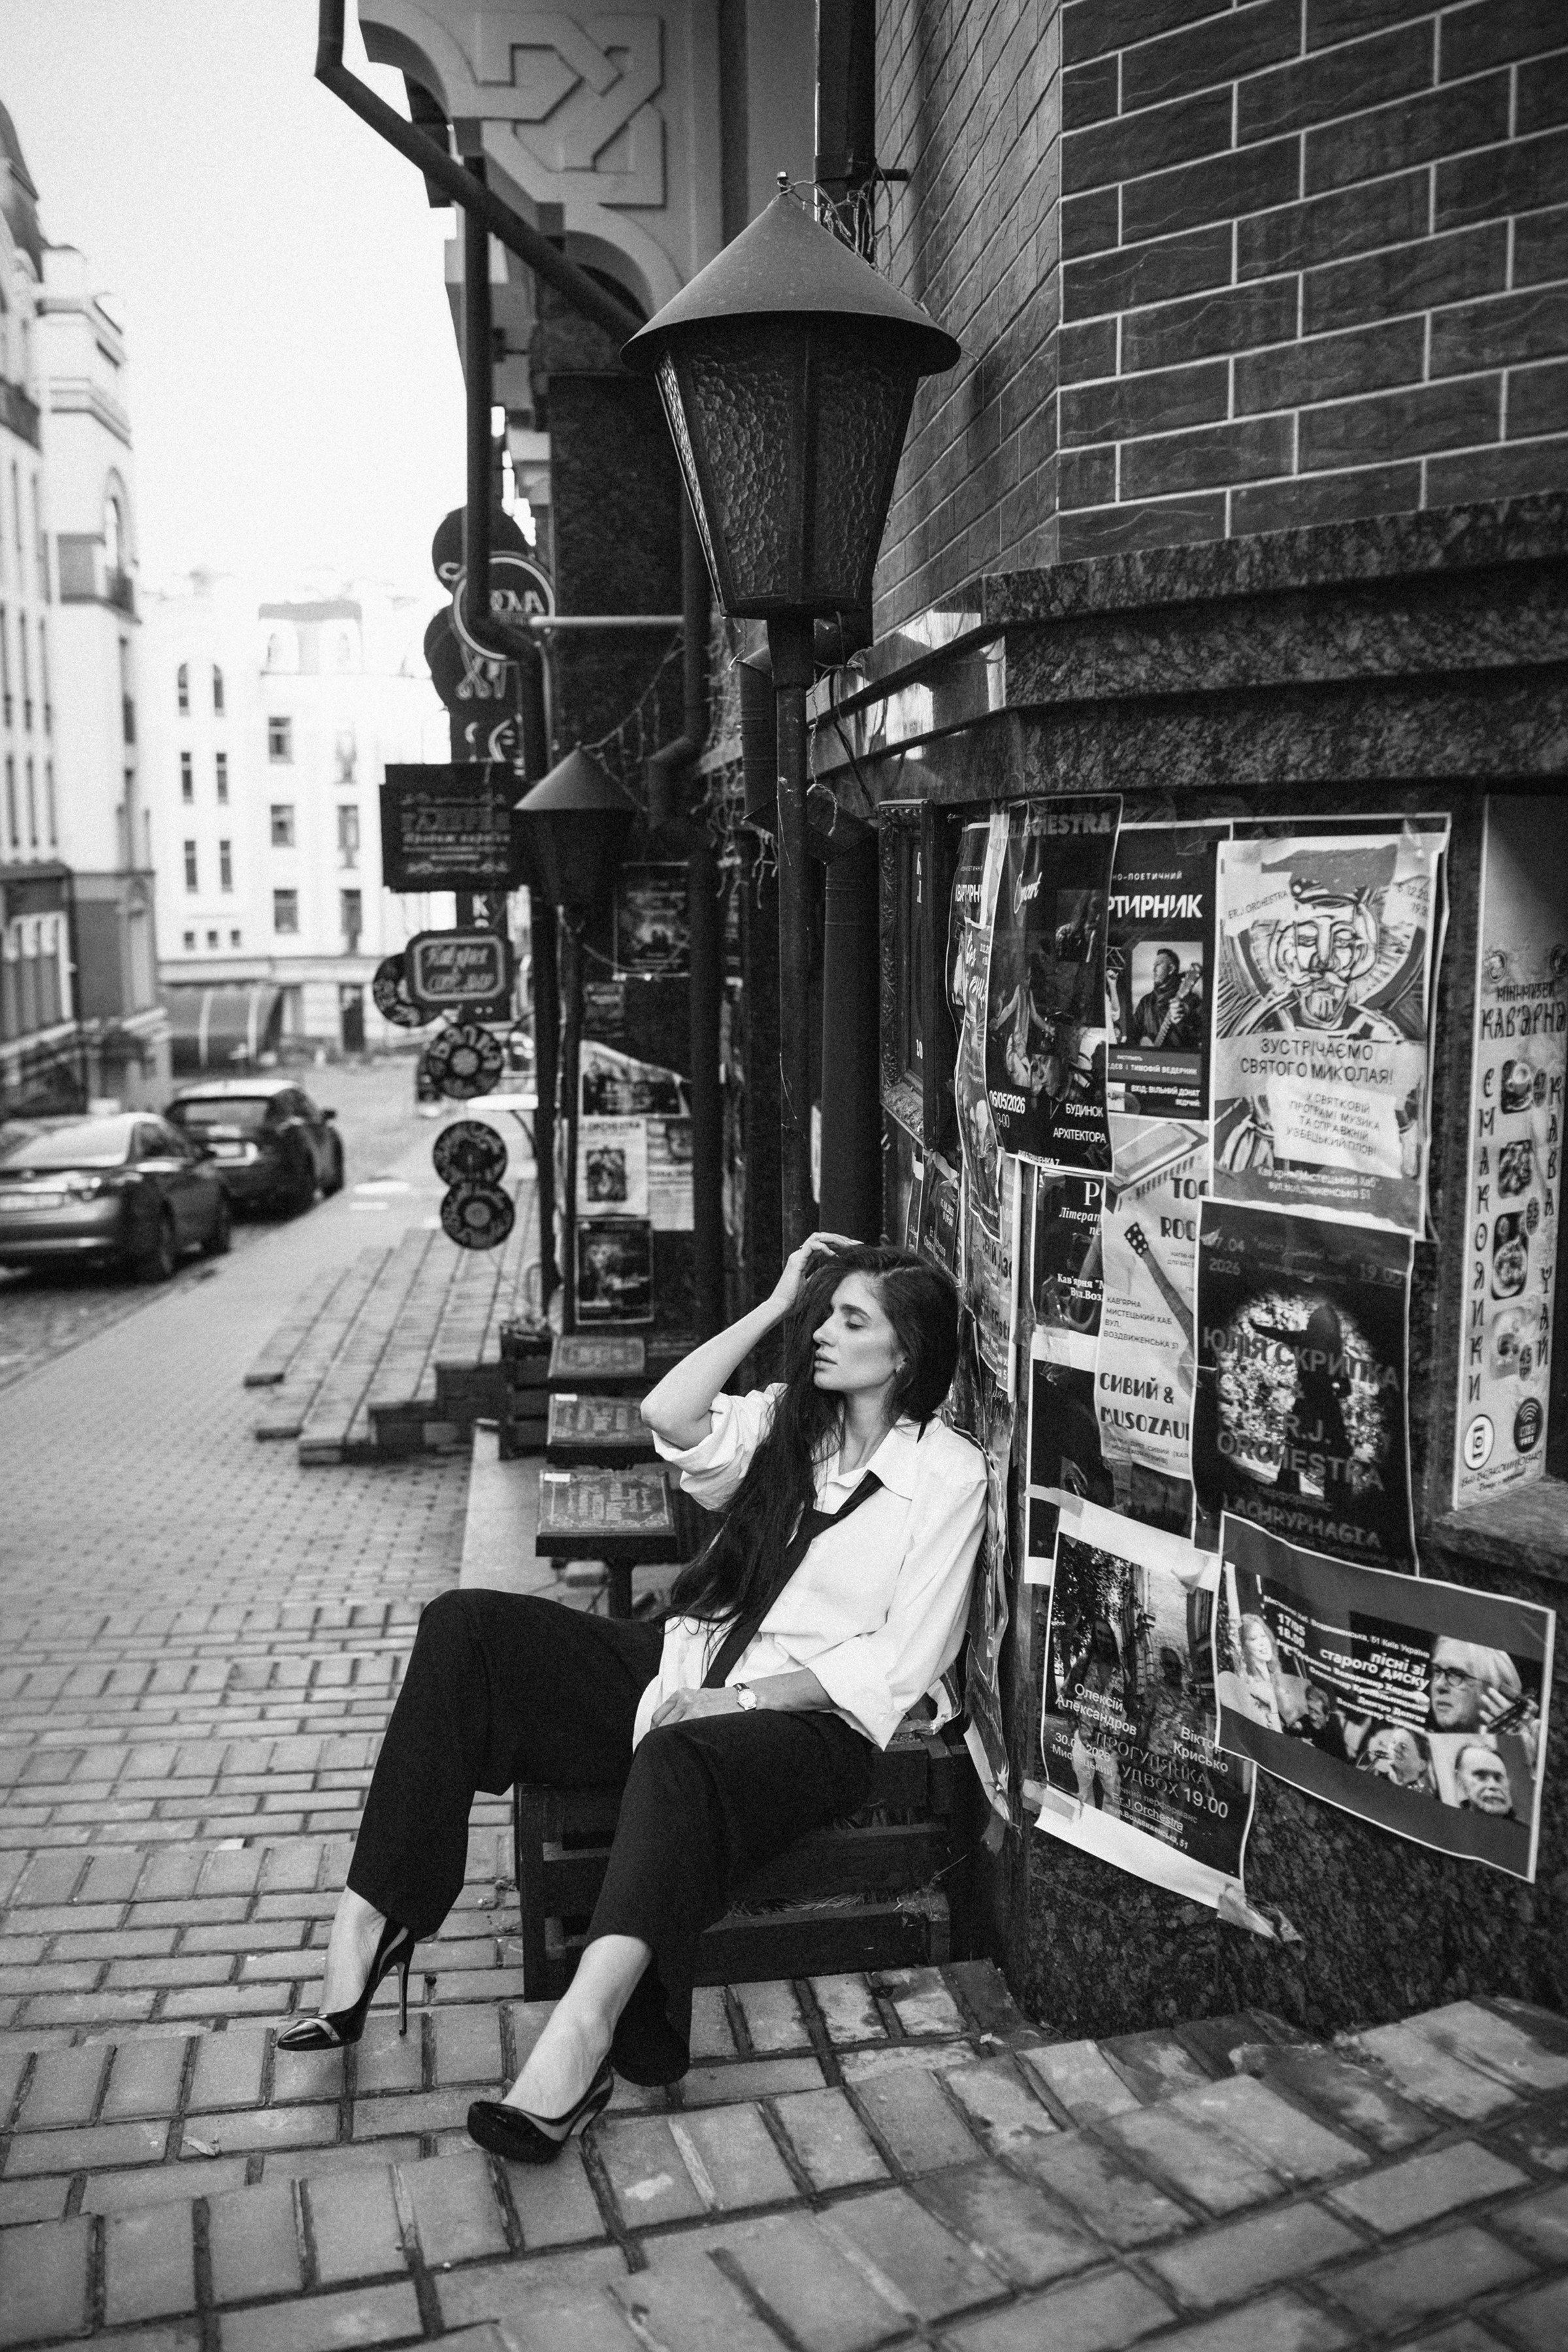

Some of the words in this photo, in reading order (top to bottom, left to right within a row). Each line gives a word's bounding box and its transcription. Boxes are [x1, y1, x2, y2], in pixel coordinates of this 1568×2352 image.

[1107, 894, 1203, 919] РТИРНИК
[1261, 1037, 1373, 1061] ЗУСТРІЧАЄМО
[1241, 1057, 1307, 1078] СВЯТОГО
[1310, 1062, 1394, 1086] МИКОЛАЯ!
[989, 1090, 1026, 1115] 06/05/2026
[1066, 1103, 1105, 1119] БУДИНОК
[1315, 1092, 1371, 1115] СВЯТКОВІЙ
[1291, 1100, 1337, 1120] ПРОГРАМІ
[1341, 1112, 1380, 1131] МУЗИКА
[1299, 1115, 1312, 1127] ТА
[1314, 1119, 1369, 1141] СПРАВЖНІЙ
[1053, 1127, 1107, 1144] АРХІТЕКТОРА
[1059, 1207, 1102, 1224] Літерат
[1057, 1273, 1093, 1288] Кав'ярня
[1105, 1307, 1155, 1322] МИСТЕЦЬКИЙ
[1156, 1316, 1173, 1325] ХАБ
[1103, 1330, 1170, 1348] ВОЗДВИЖЕНСЬКА
[1100, 1372, 1158, 1400] СИВИЙ
[1163, 1386, 1174, 1405] &
[1100, 1406, 1189, 1441] MUSOZAU
[1520, 1435, 1534, 1446] FREE
[1217, 1431, 1384, 1492] ORCHESTRA
[1277, 1612, 1306, 1637] 17/05
[1277, 1625, 1305, 1648] 18.00
[1381, 1638, 1399, 1650] Київ
[1401, 1644, 1431, 1659] Україна
[1320, 1648, 1379, 1674] старого
[1380, 1667, 1430, 1691] диску
[1371, 1652, 1410, 1672] пісні
[1411, 1663, 1427, 1677] зі
[1075, 1683, 1123, 1712] Олексій
[1055, 1695, 1137, 1735] Александров
[1181, 1725, 1223, 1754] Віктор
[1096, 1731, 1206, 1785] ПРОГУЛЯНКА
[1173, 1741, 1228, 1772] Крисько
[1121, 1763, 1179, 1799] УДВОХ
[1184, 1788, 1228, 1819] 19.00
[1179, 1838, 1189, 1850] 51
